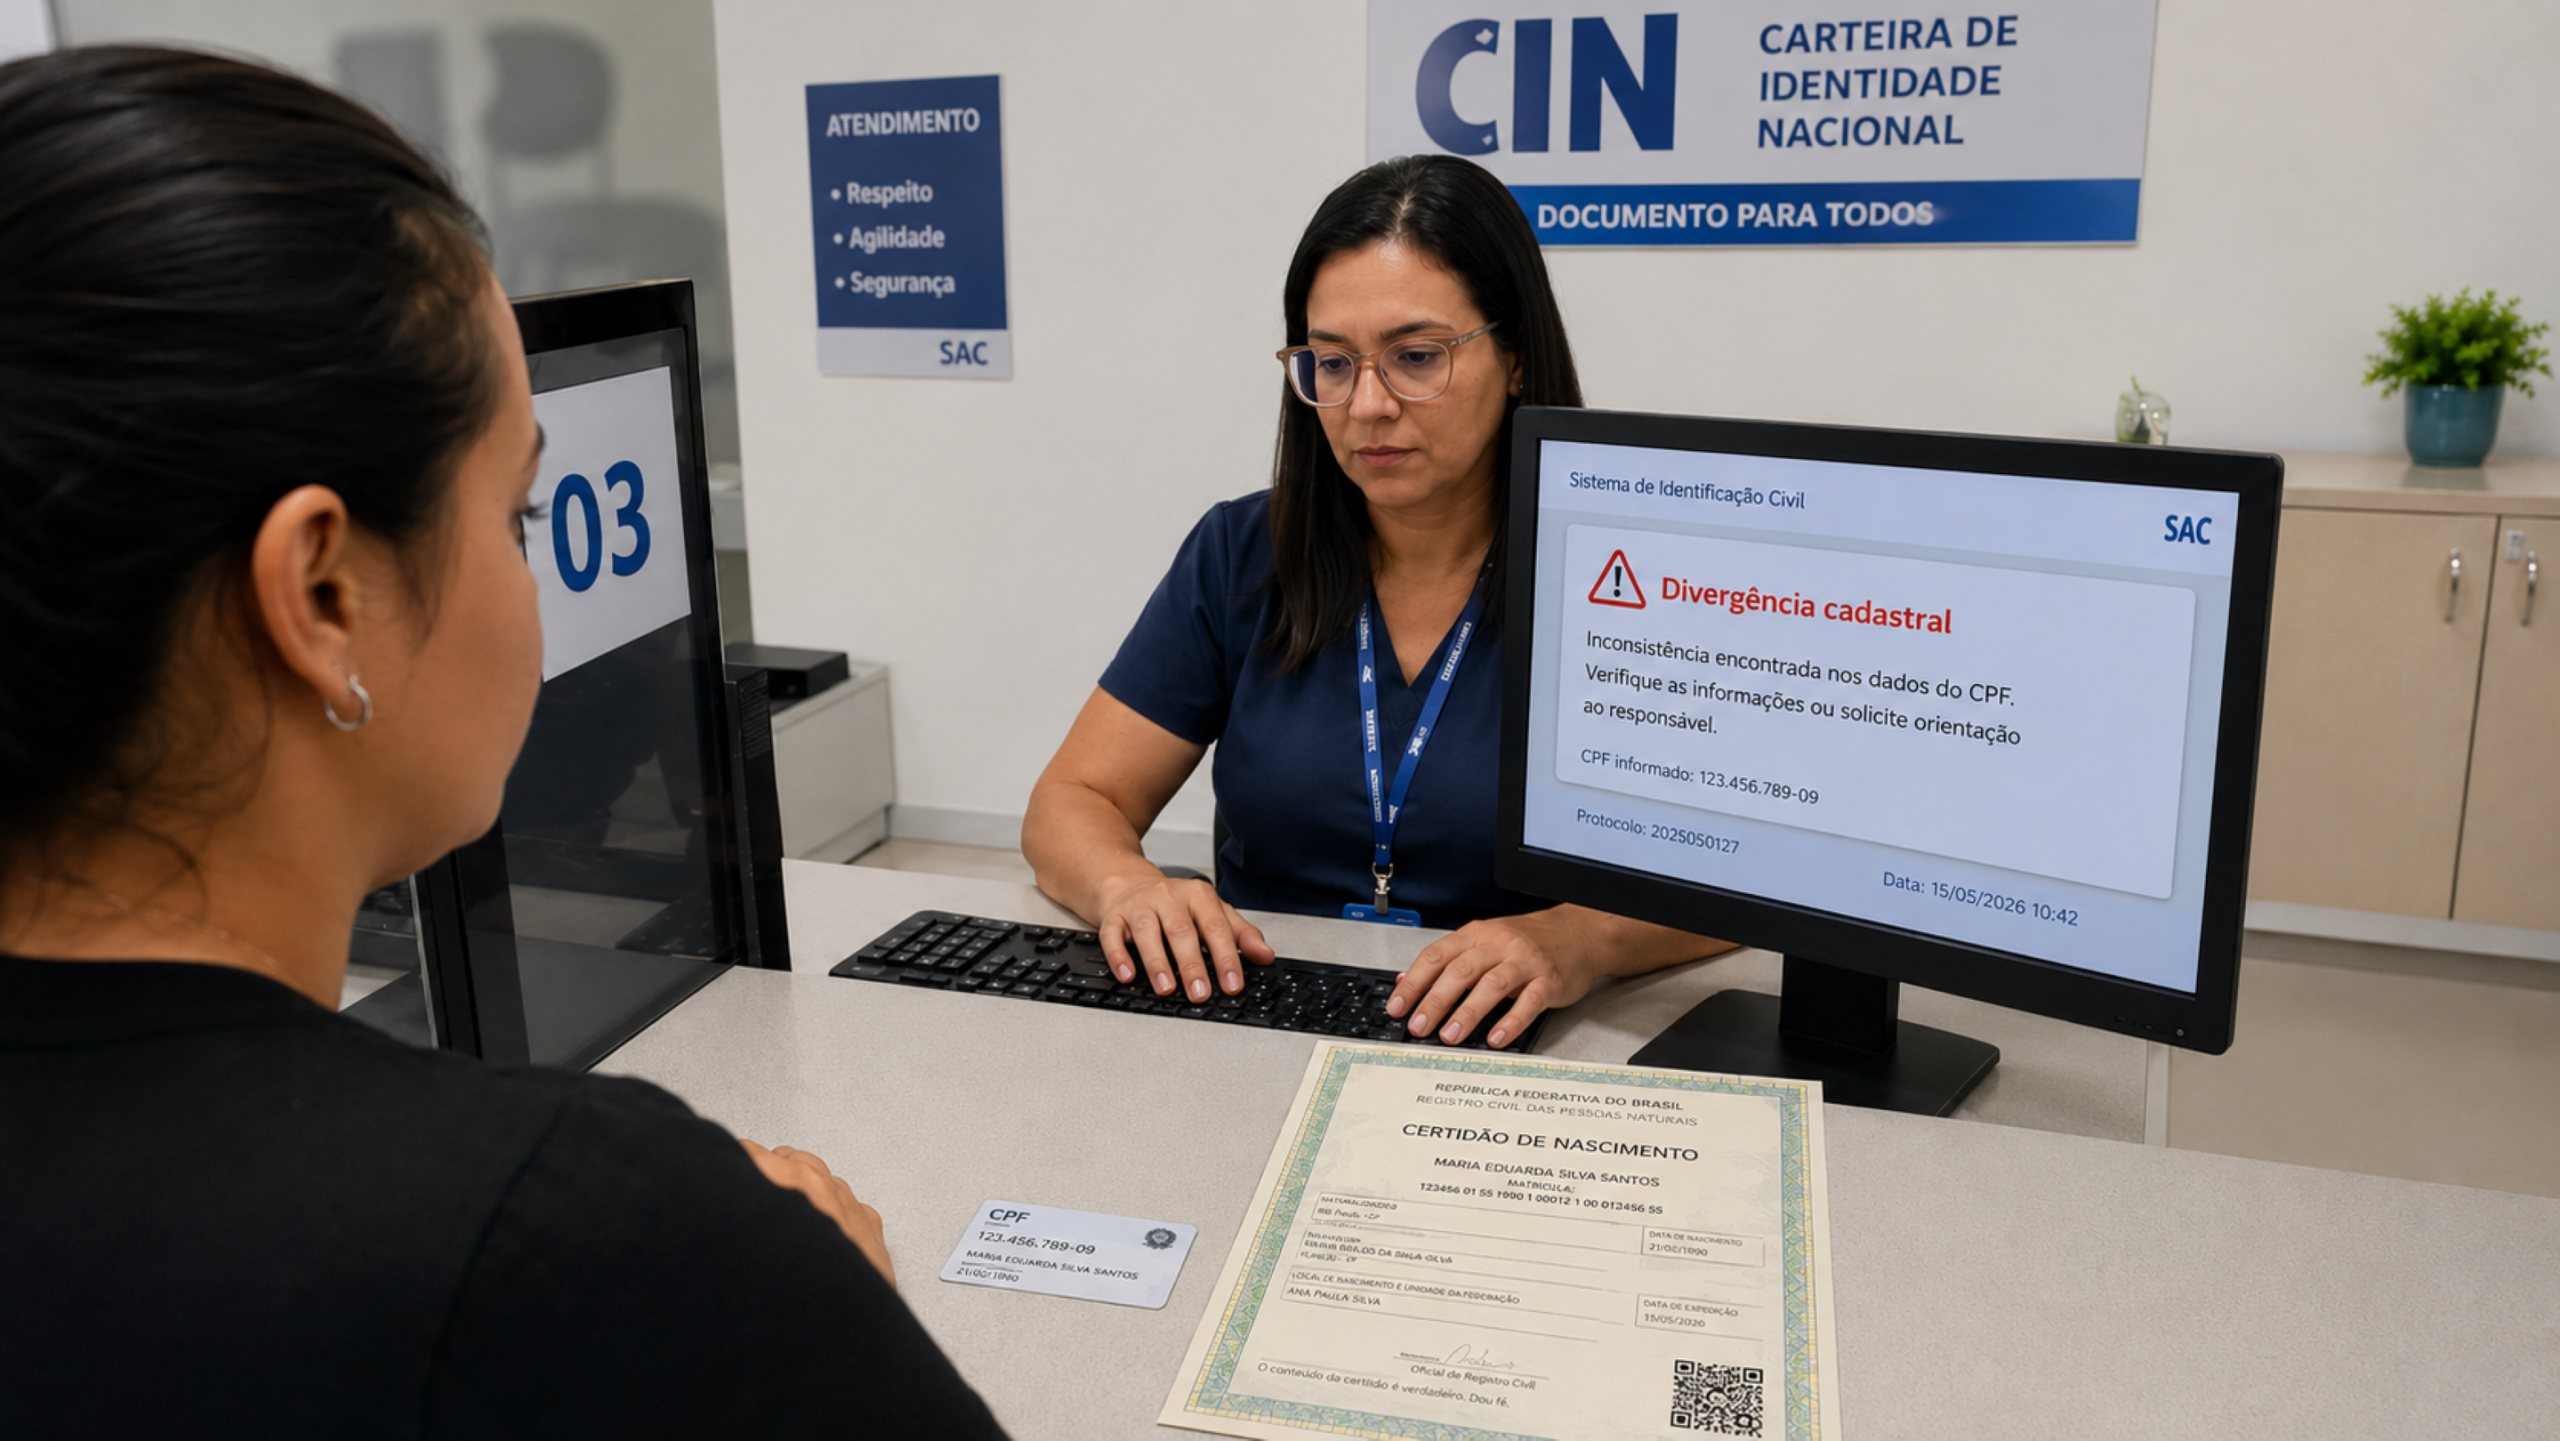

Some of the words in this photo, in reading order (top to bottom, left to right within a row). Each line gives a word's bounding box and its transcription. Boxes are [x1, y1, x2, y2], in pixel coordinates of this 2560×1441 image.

[1760, 18, 1952, 55] CARTEIRA
[1966, 15, 2018, 48] DE
[1416, 13, 1678, 156] CIN
[1760, 65, 2001, 101] IDENTIDADE
[826, 108, 980, 137] ATENDIMENTO
[1758, 115, 1964, 148] NACIONAL
[847, 180, 933, 208] Respeito
[1538, 204, 1728, 229] DOCUMENTO
[1737, 203, 1818, 228] PARA
[1826, 201, 1934, 227] TODOS
[849, 225, 945, 254] Agilidade
[850, 271, 955, 299] Segurança
[940, 341, 988, 366] SAC
[1570, 471, 1630, 493] Sistema
[1634, 477, 1654, 495] de
[1659, 480, 1764, 507] Identificação
[1769, 489, 1805, 509] Civil
[551, 460, 651, 593] 03
[2164, 514, 2212, 546] SAC
[1662, 576, 1815, 618] Divergência
[1824, 600, 1951, 634] cadastral
[1586, 630, 1709, 664] Inconsistência
[1715, 653, 1821, 679] encontrada
[1828, 667, 1862, 685] nos
[1868, 670, 1930, 695] dados
[1936, 678, 1962, 699] do
[1969, 683, 2015, 706] CPF.
[1583, 700, 1604, 716] ao
[1609, 703, 1717, 734] responsável.
[1585, 663, 1662, 692] Verifique
[1668, 679, 1687, 695] as
[1692, 679, 1804, 713] informações
[1810, 701, 1834, 717] ou
[1840, 704, 1908, 728] solicite
[1914, 715, 2021, 746] orientação
[1581, 748, 1611, 766] CPF
[1615, 754, 1694, 783] informado:
[1700, 770, 1819, 804] 123.456.789-09
[1577, 808, 1647, 836] Protocolo:
[1883, 871, 1925, 894] Data:
[1931, 882, 2026, 915] 15/05/2026
[2032, 902, 2078, 926] 10:42
[1416, 1095, 1484, 1109] REGISTRO
[1487, 1101, 1521, 1112] CIVIL
[1526, 1103, 1555, 1114] DAS
[1560, 1107, 1622, 1120] PESSOAS
[1627, 1112, 1698, 1127] NATURAIS
[1605, 1096, 1627, 1106] DO
[1632, 1099, 1684, 1111] BRASIL
[1402, 1123, 1509, 1146] CERTIDÃO
[1517, 1133, 1547, 1148] DE
[1554, 1137, 1699, 1162] NASCIMENTO
[1434, 1157, 1481, 1171] MARIA
[1485, 1162, 1555, 1178] EDUARDA
[1559, 1168, 1597, 1181] SILVA
[1600, 1172, 1660, 1187] SANTOS
[989, 1208, 1031, 1224] CPF
[1093, 1267, 1139, 1281] SANTOS
[1257, 1362, 1268, 1372] O
[1468, 1392, 1494, 1404] Dou
